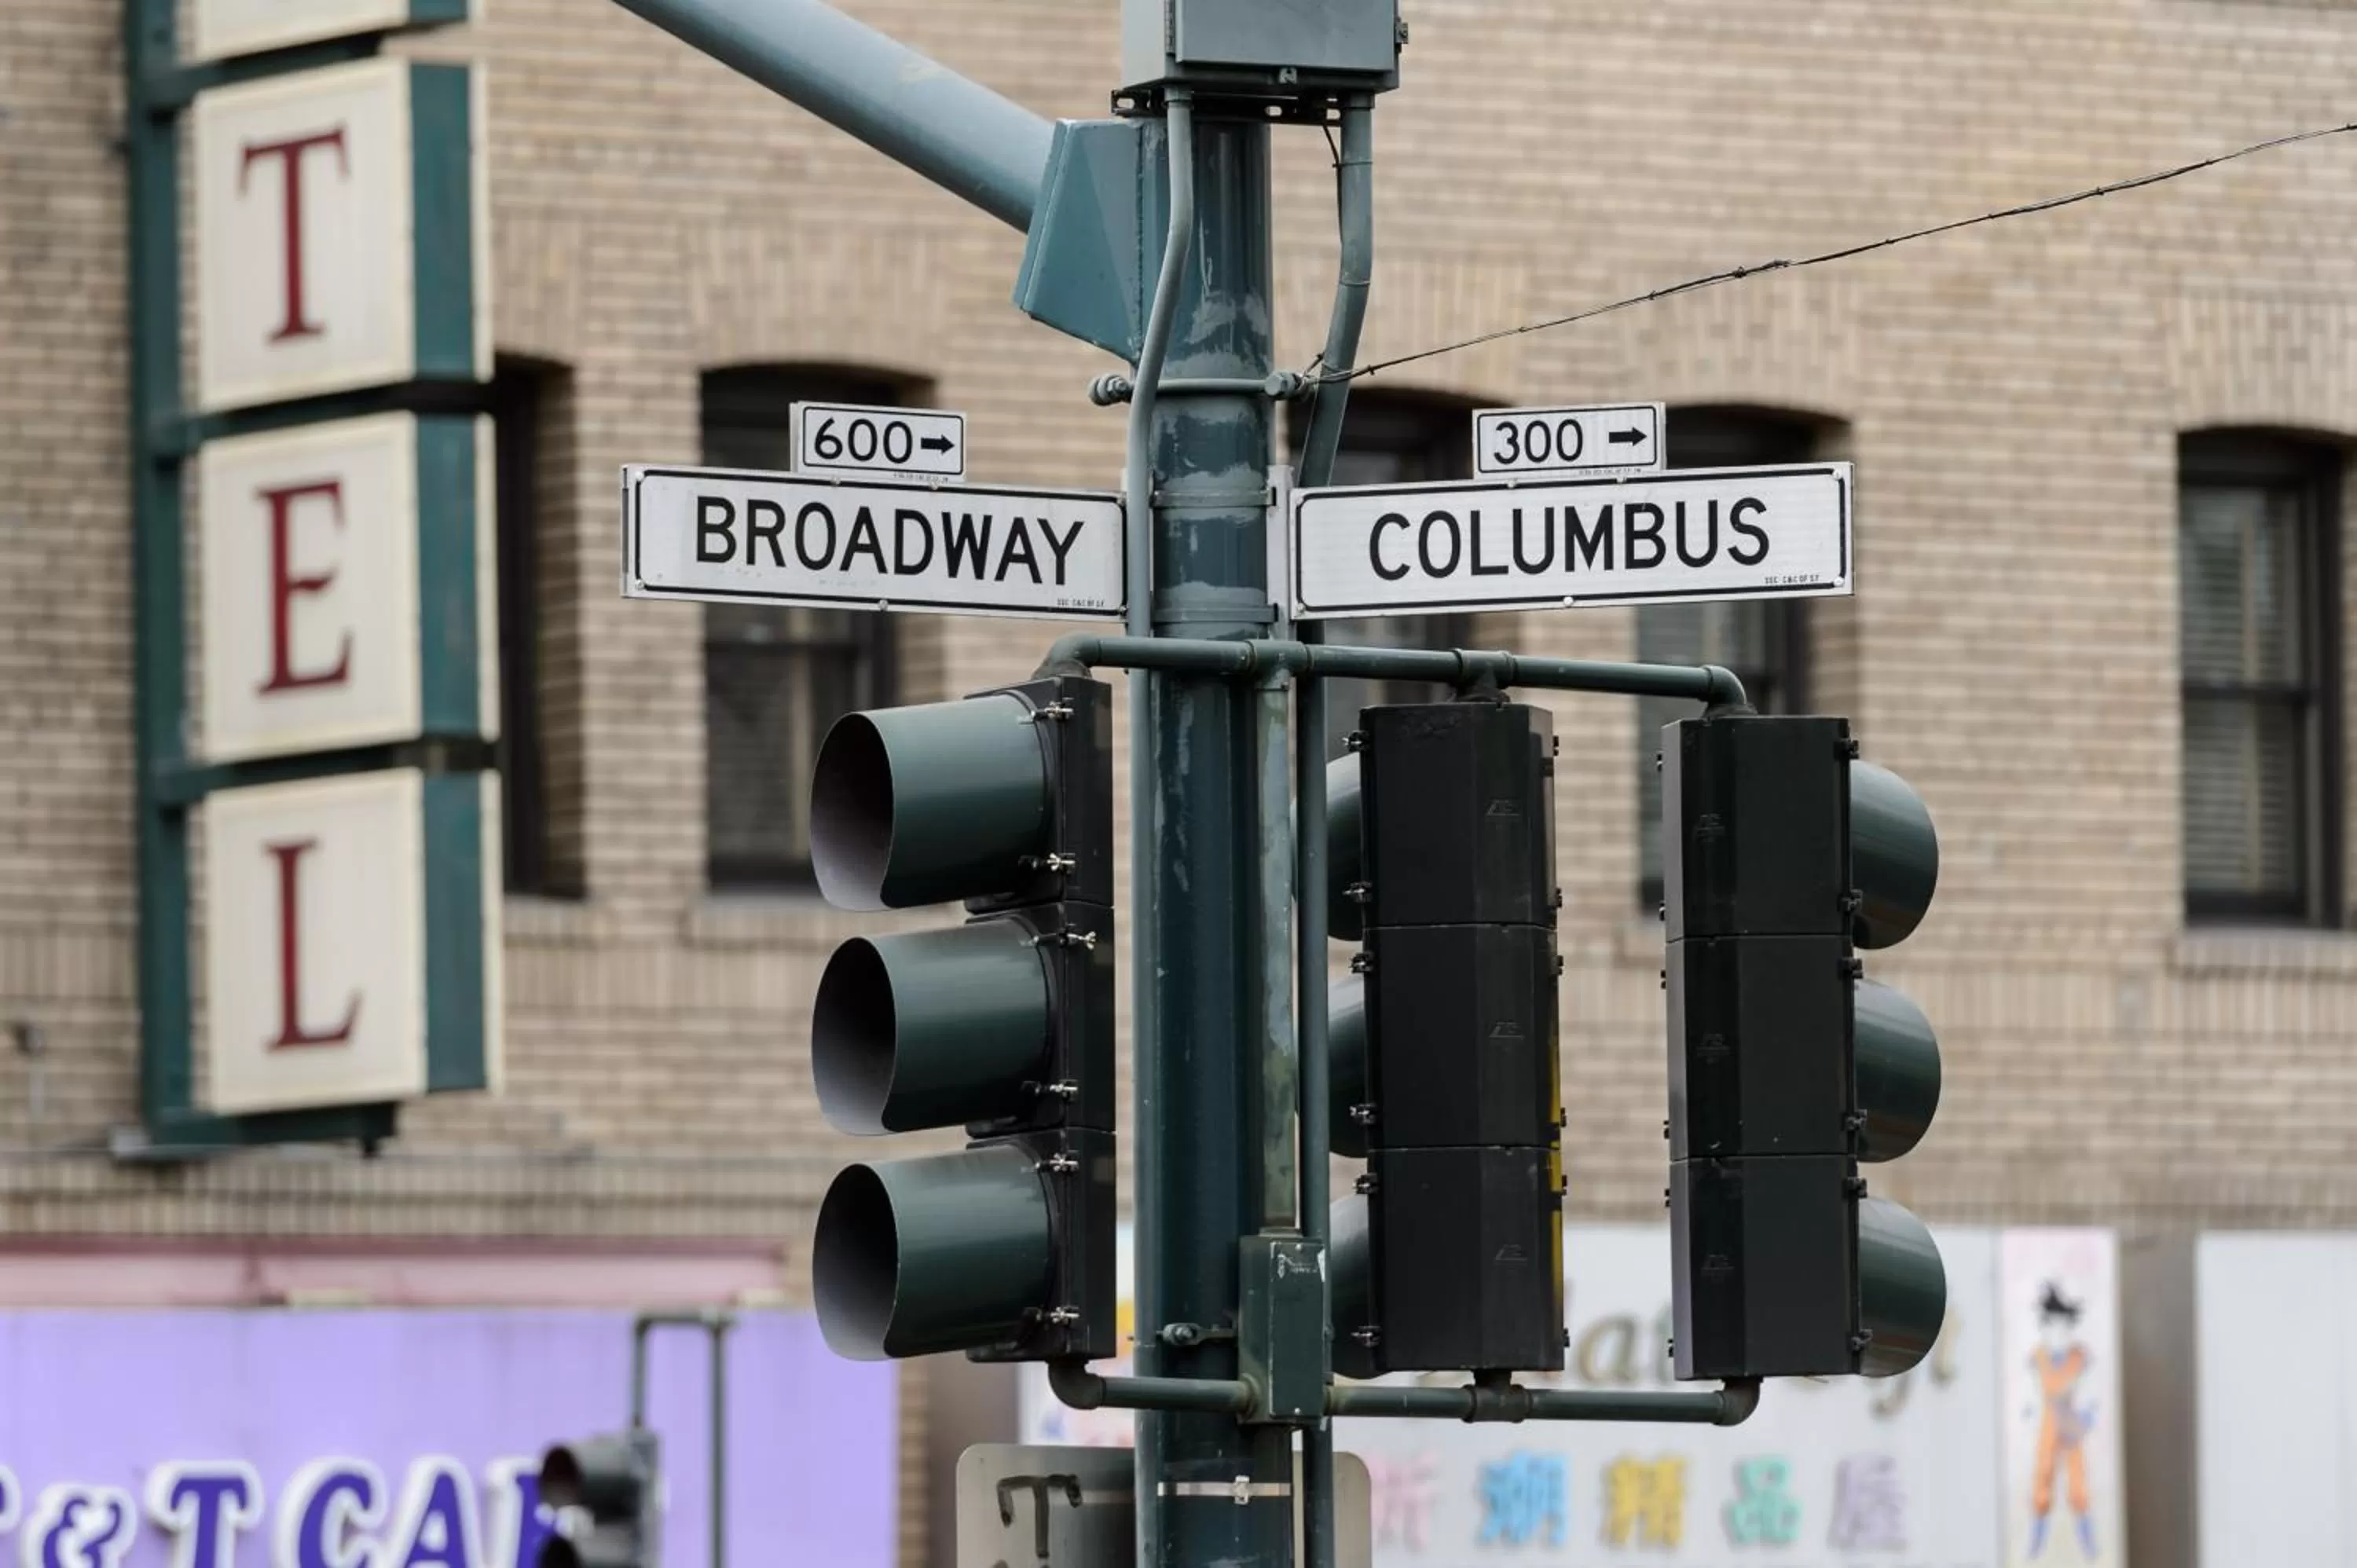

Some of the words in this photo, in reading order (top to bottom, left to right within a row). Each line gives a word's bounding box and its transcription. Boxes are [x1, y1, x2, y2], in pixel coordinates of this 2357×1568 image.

[813, 416, 914, 465] 600
[1493, 418, 1584, 466] 300
[695, 495, 1085, 587] BROADWAY
[1369, 496, 1770, 581] COLUMBUS
